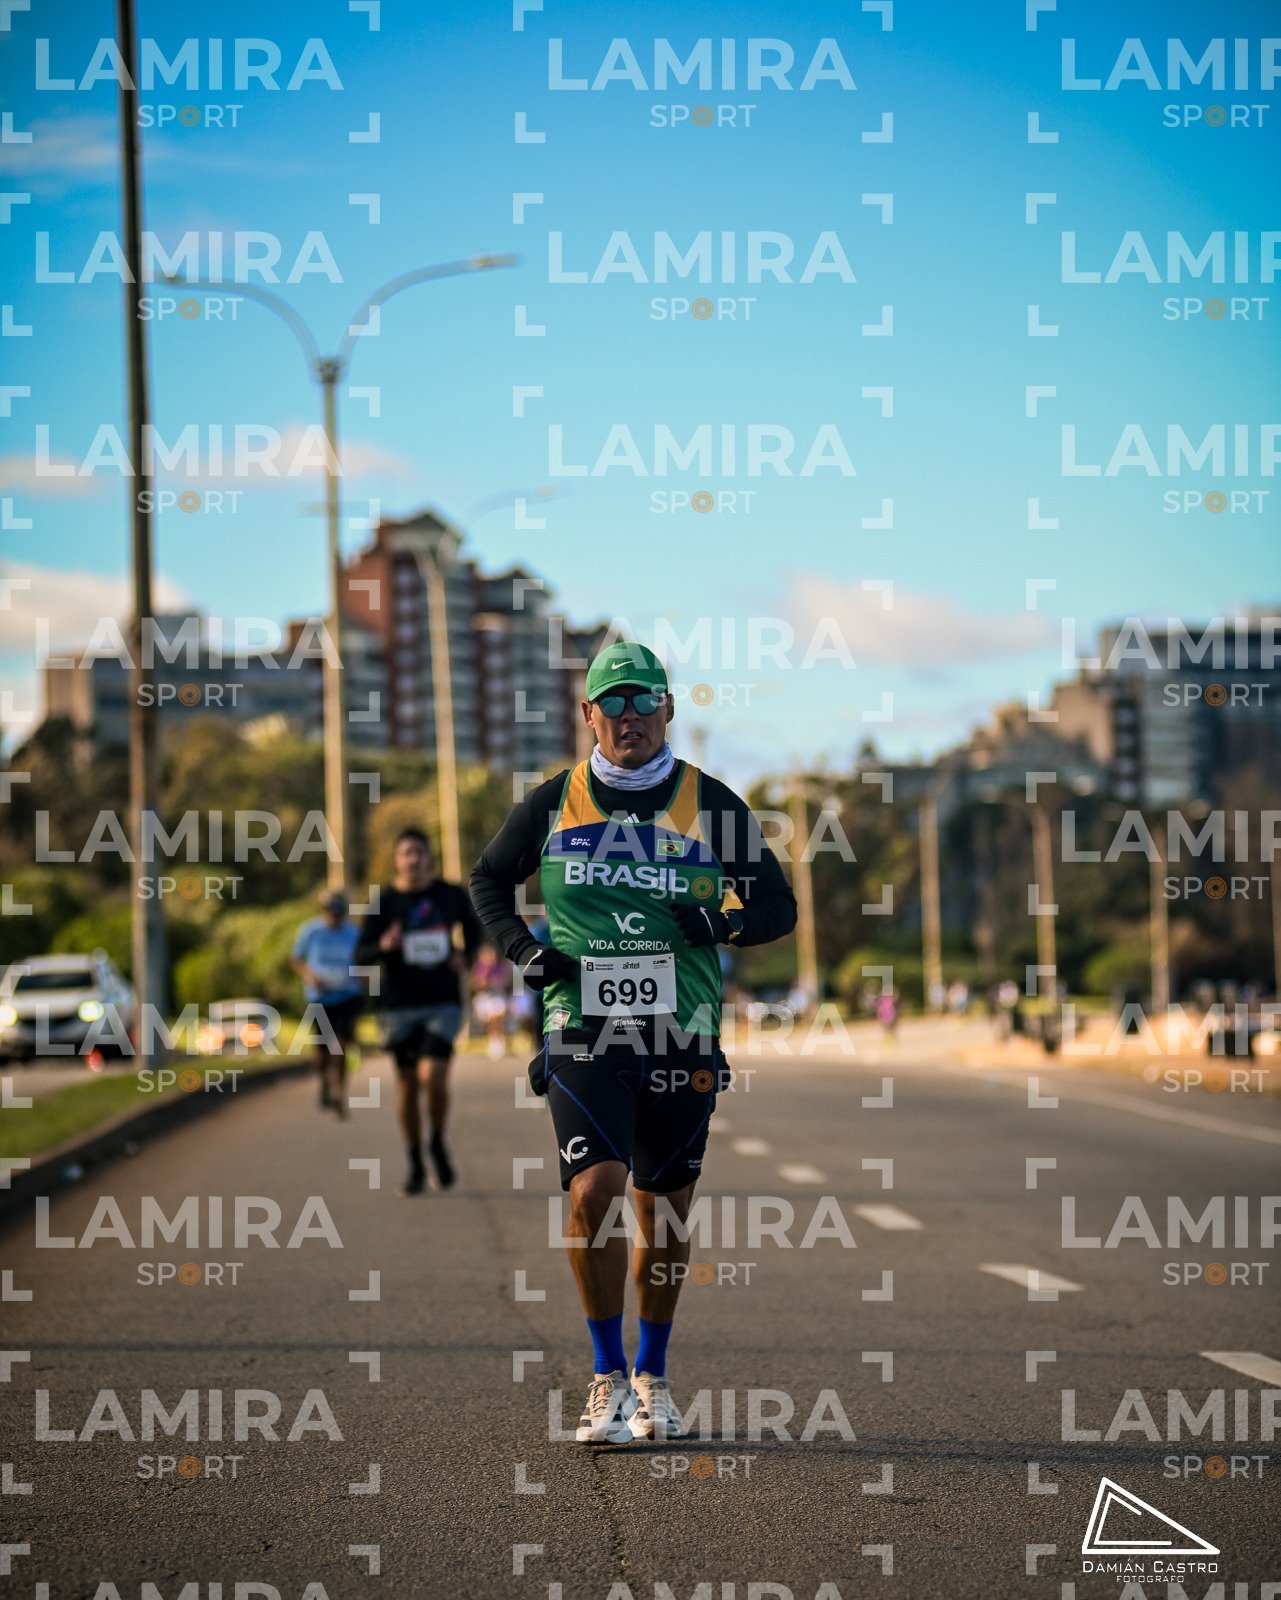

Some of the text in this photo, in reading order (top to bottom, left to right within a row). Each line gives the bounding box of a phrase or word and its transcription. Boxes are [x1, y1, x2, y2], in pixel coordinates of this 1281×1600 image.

[564, 861, 688, 893] BRASIL
[588, 939, 671, 951] VIDA CORRIDA
[598, 977, 658, 1007] 699
